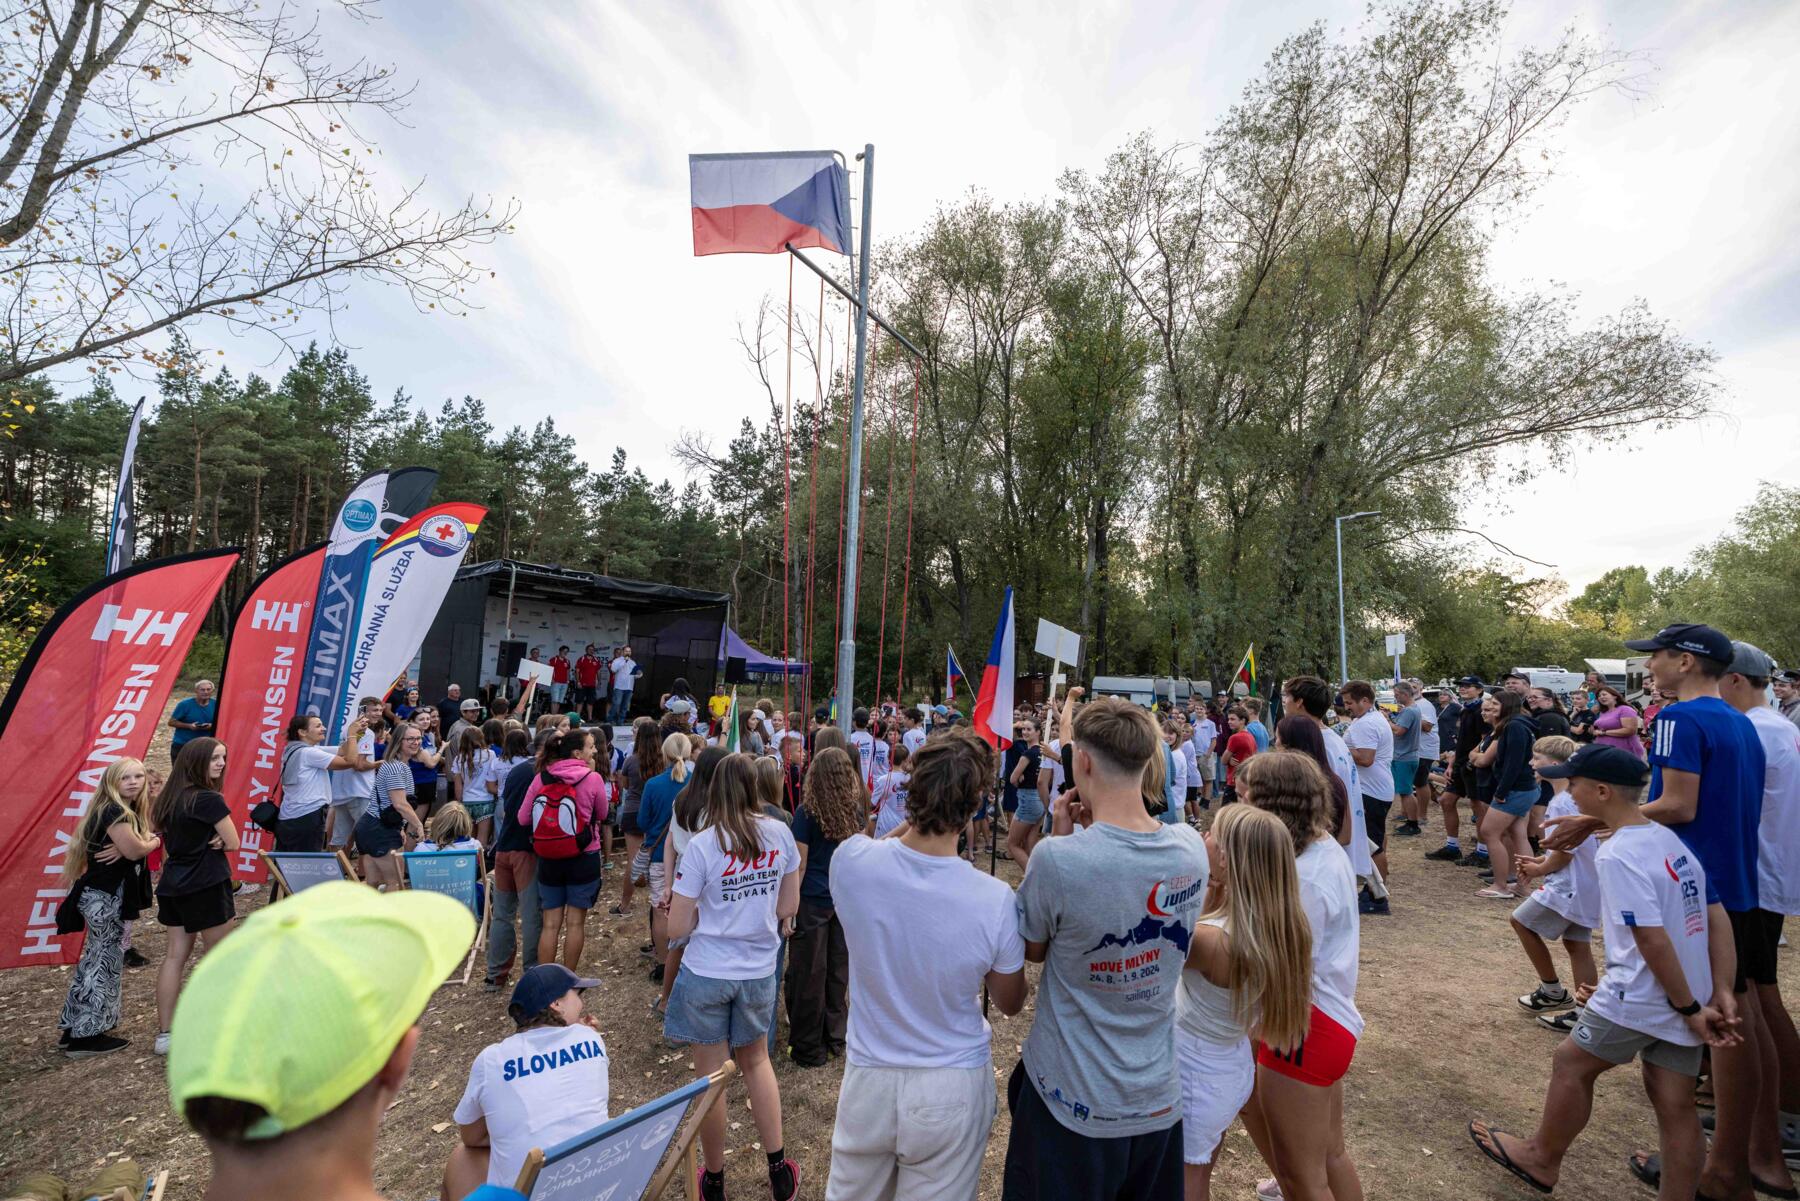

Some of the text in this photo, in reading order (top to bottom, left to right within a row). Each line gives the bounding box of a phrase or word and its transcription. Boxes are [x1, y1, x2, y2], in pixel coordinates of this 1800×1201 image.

[344, 509, 375, 521] OPTIMAX
[382, 549, 415, 600] SLUŽBA
[254, 646, 295, 769] HANSEN
[62, 663, 160, 817] HANSEN
[1089, 948, 1161, 973] NOVÉ MLÝNY
[1140, 964, 1160, 978] 2024
[1125, 985, 1161, 1002] sailing.cz
[503, 1040, 604, 1081] SLOVAKIA
